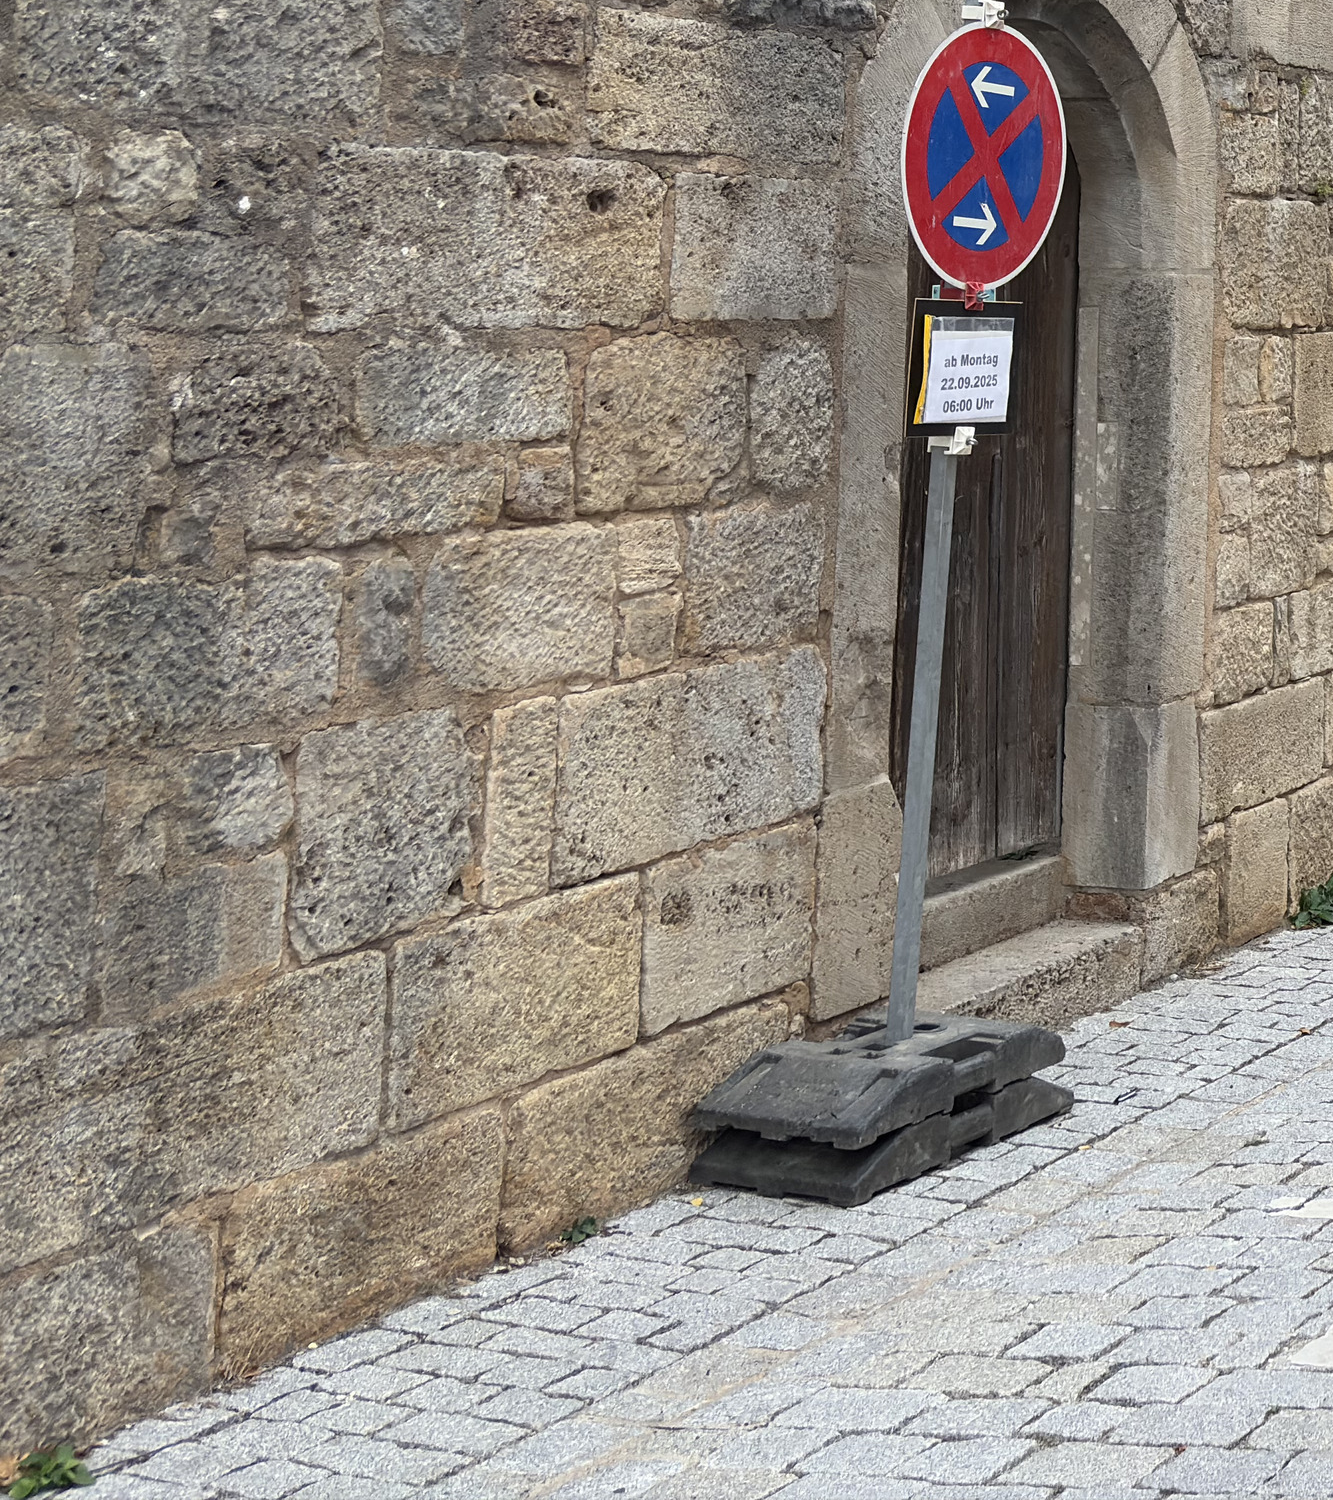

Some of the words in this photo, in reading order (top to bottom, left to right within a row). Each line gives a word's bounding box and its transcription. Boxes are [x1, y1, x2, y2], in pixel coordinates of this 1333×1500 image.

[944, 355, 957, 368] ab
[960, 353, 999, 368] Montag
[940, 374, 998, 391] 22.09.2025
[942, 398, 973, 413] 06:00
[976, 397, 994, 411] Uhr
